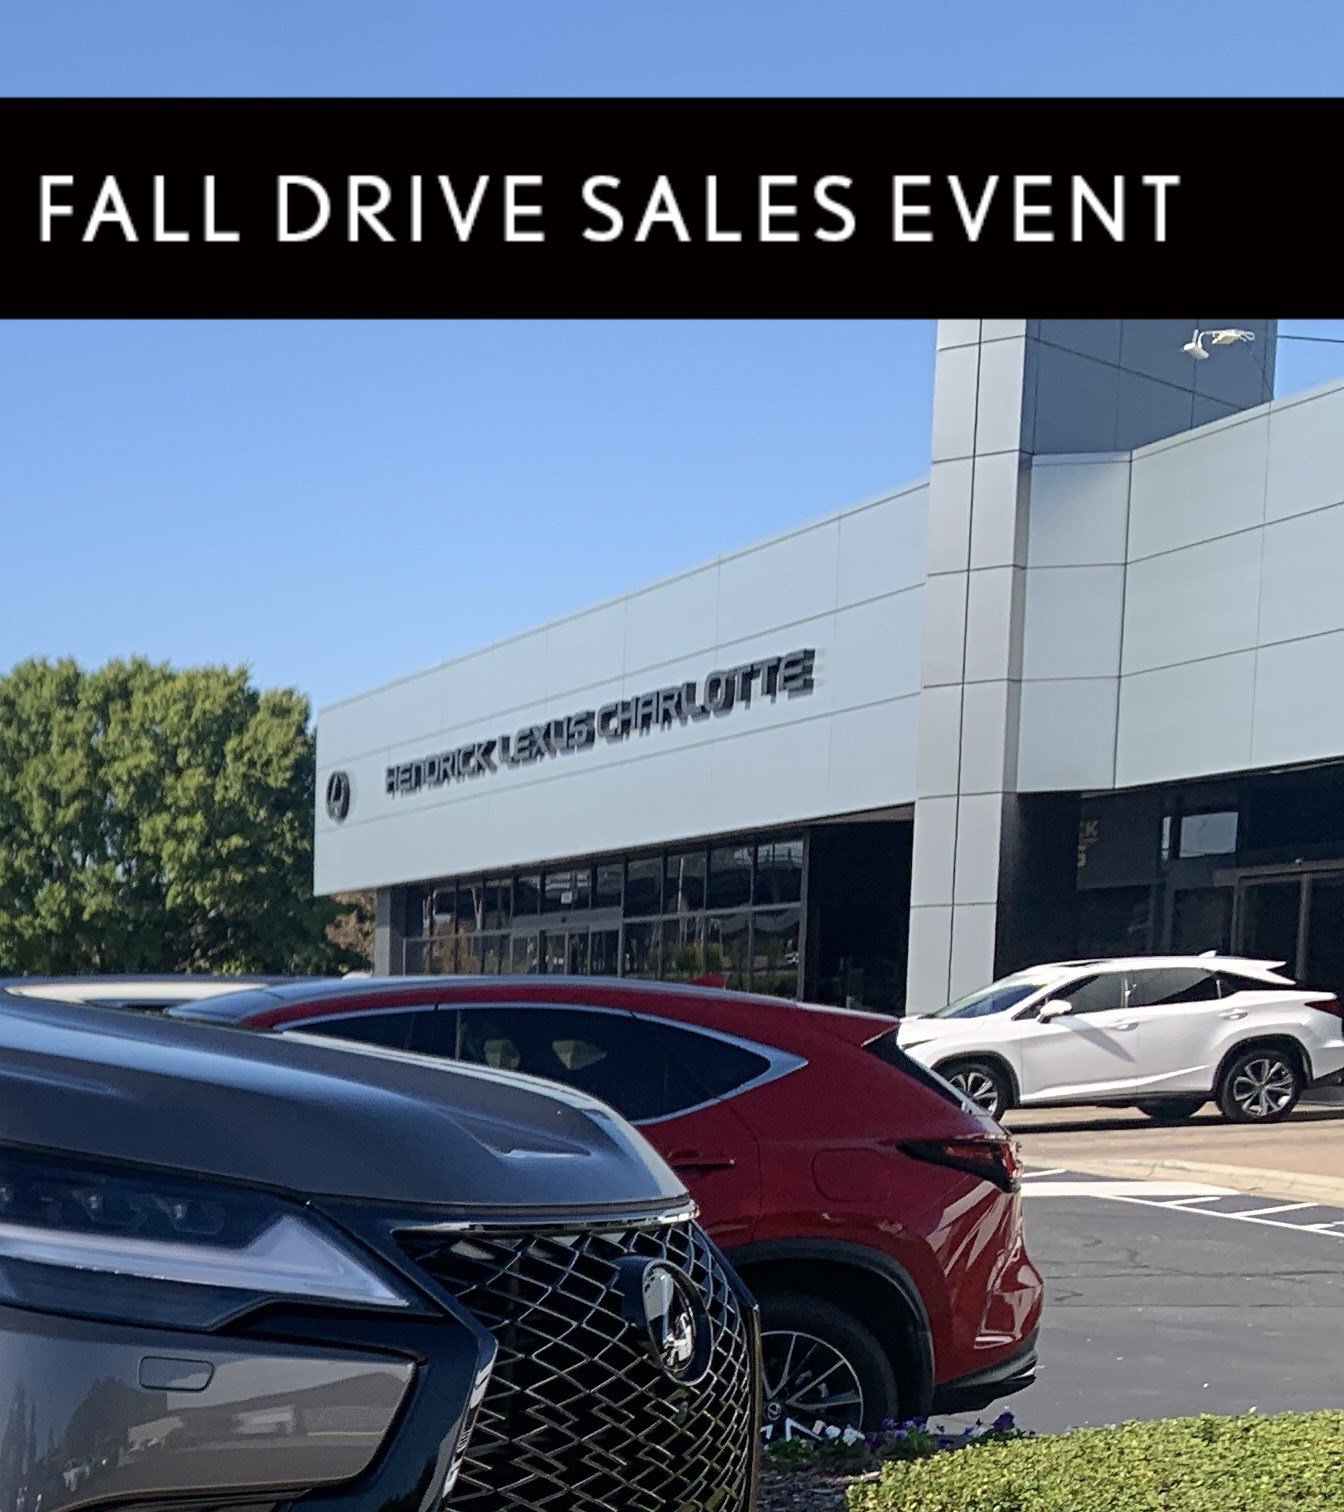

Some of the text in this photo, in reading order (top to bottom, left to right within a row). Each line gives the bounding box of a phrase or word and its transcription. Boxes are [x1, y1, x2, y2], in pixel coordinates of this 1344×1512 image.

[385, 648, 817, 799] HENDRICK LEXUS CHARLOTTE
